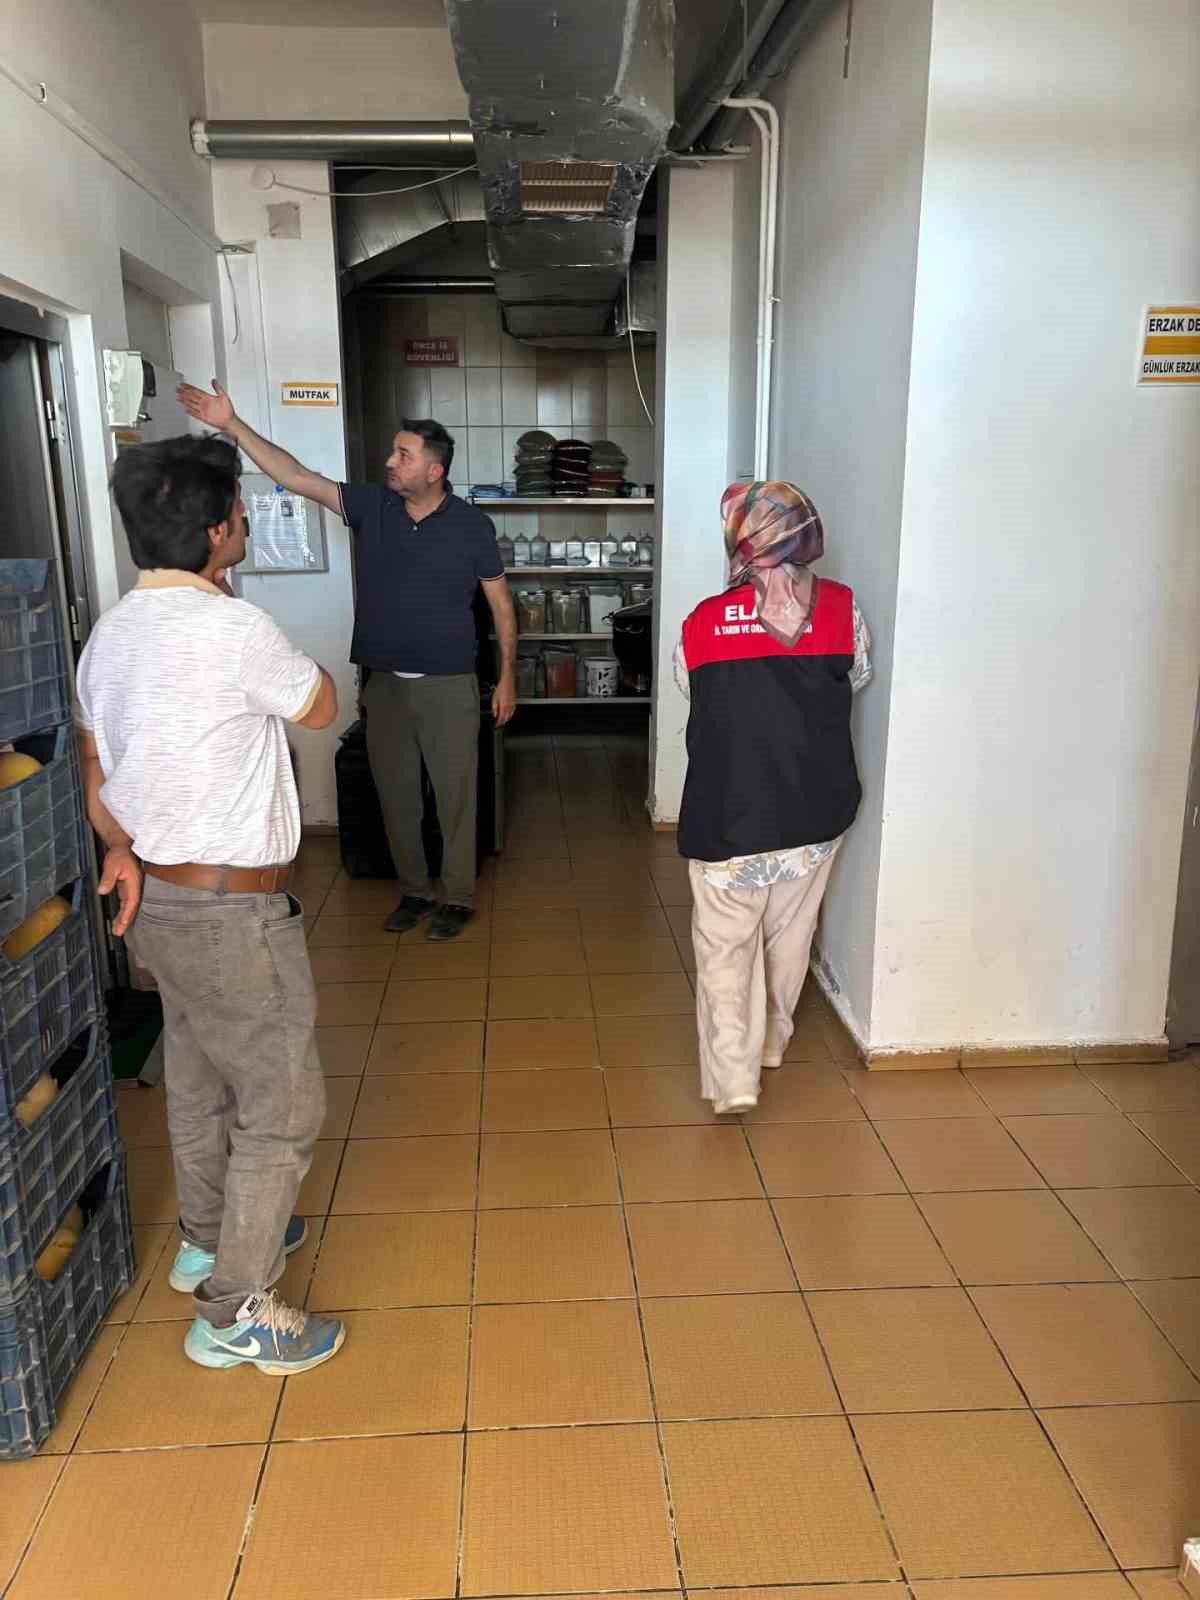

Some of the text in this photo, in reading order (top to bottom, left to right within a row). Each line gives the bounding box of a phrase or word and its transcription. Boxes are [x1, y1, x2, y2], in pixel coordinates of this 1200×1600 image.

[1149, 318, 1185, 332] ERZAK
[1143, 359, 1174, 373] GÜNLÜK
[289, 390, 330, 399] MUTFAK
